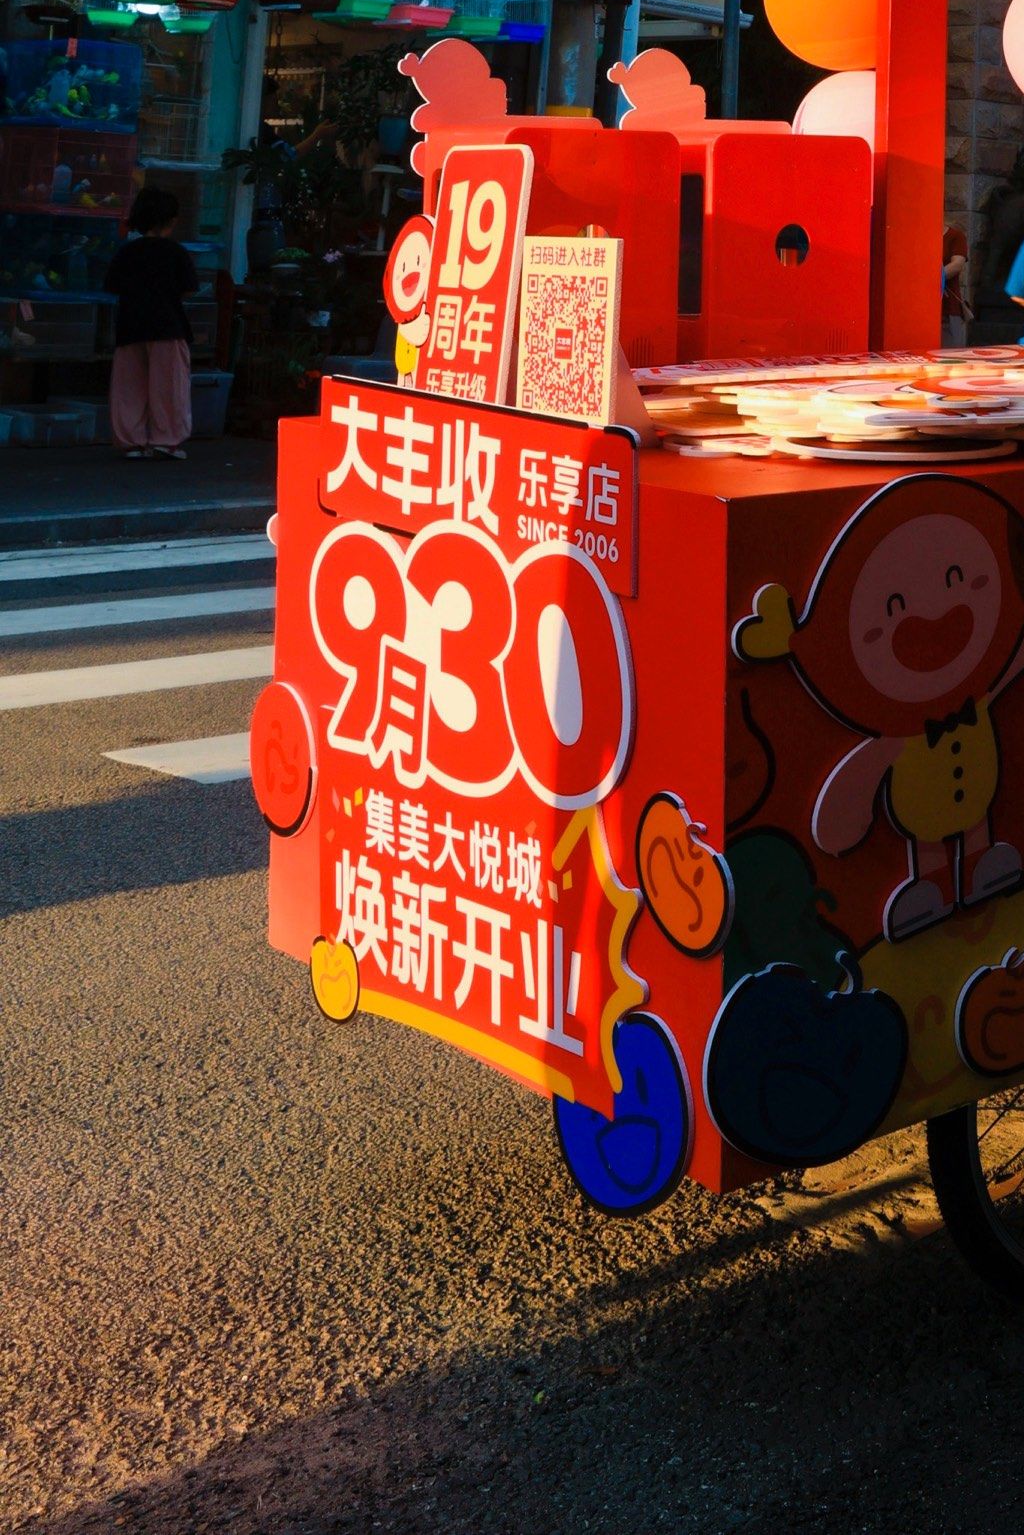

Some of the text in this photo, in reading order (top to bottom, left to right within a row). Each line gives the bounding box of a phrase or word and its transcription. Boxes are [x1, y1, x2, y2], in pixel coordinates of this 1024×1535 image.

[437, 179, 507, 290] 19
[530, 245, 607, 268] 扫码进入社群
[427, 294, 497, 365] 周年
[425, 367, 487, 402] 乐享升级
[326, 395, 502, 534] 大丰收
[517, 448, 621, 527] 乐享店
[517, 514, 620, 563] SINCE 2006
[363, 788, 543, 907] 集美大悦城
[335, 850, 585, 1057] 焕新开业
